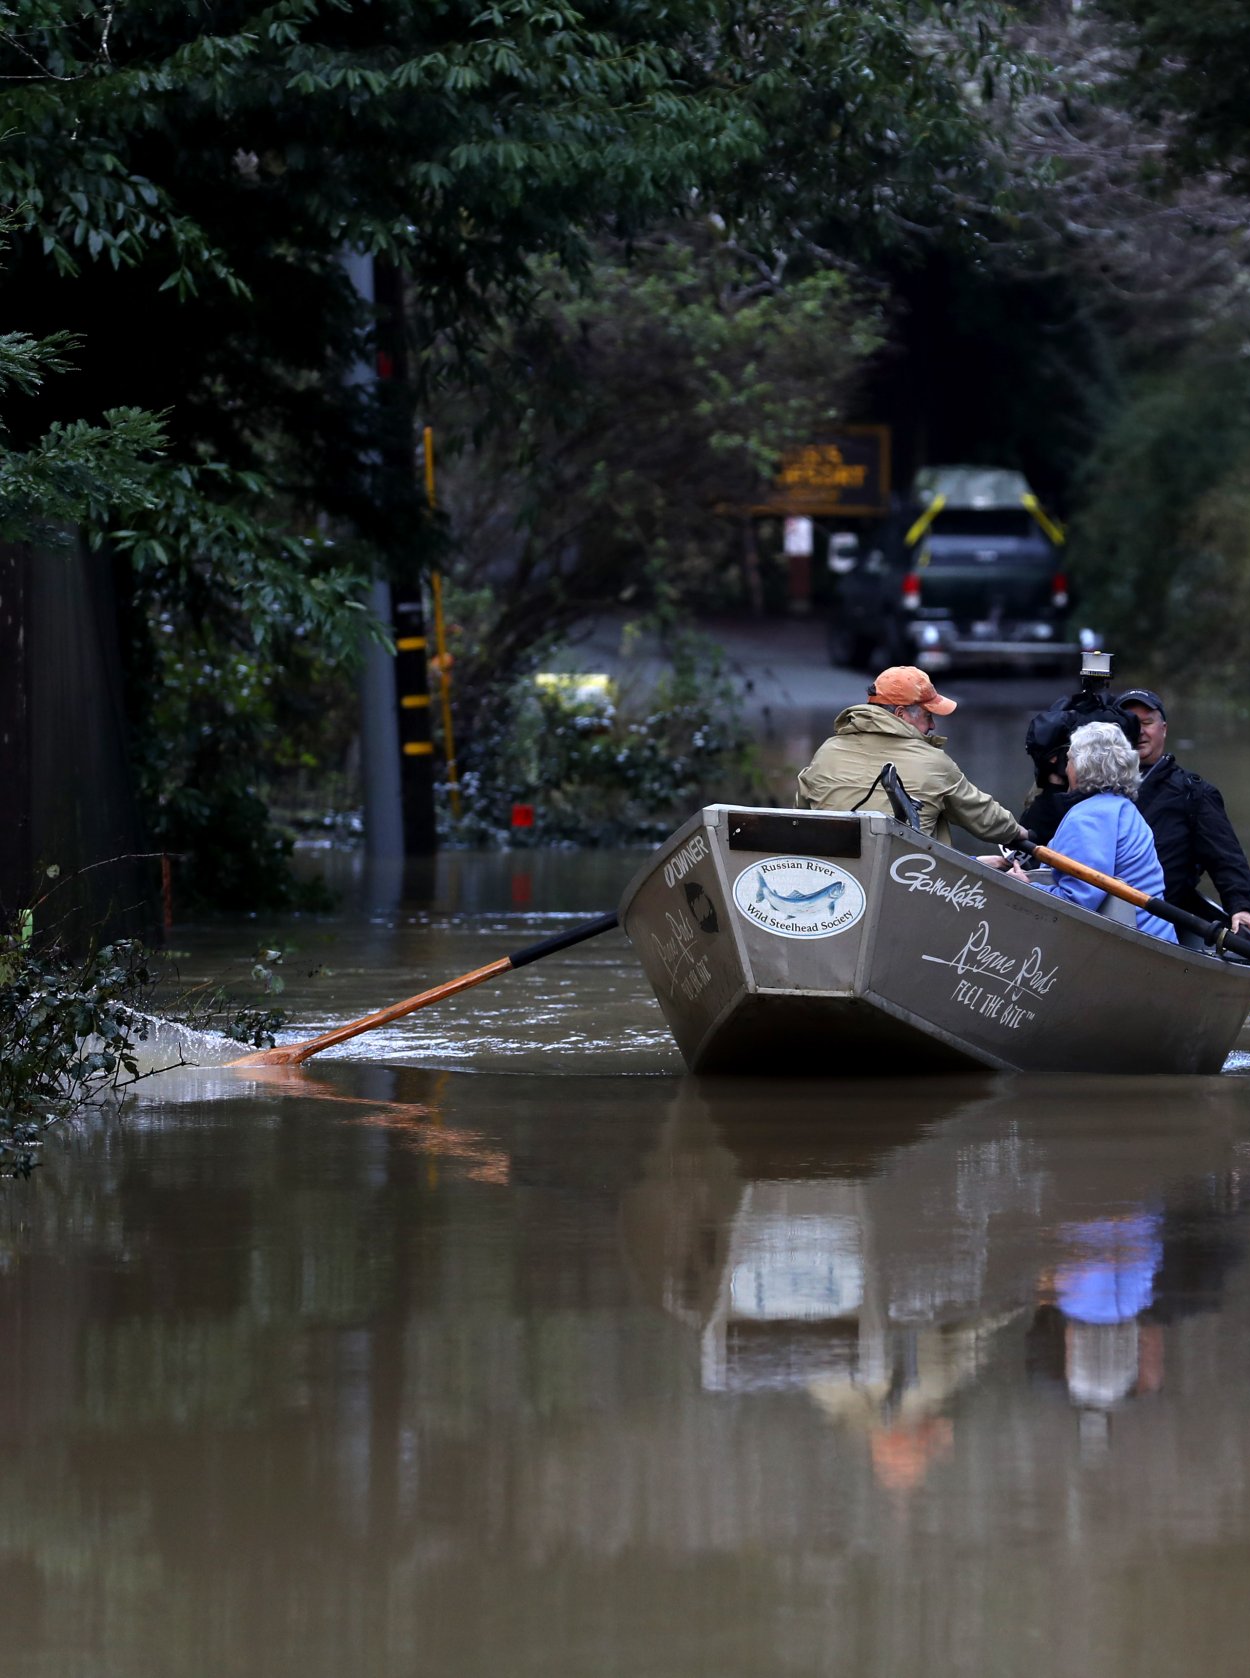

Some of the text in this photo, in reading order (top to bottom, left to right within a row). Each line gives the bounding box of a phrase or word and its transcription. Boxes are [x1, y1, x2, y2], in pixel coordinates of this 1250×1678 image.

[671, 835, 710, 880] OWNER
[761, 859, 836, 878] Russian River
[889, 852, 988, 912] Gamakatsu
[746, 903, 855, 933] Wild Steelhead Society
[949, 920, 1059, 1001] Rogue Rods
[950, 979, 984, 1010] FEEL
[979, 993, 1005, 1018] THE
